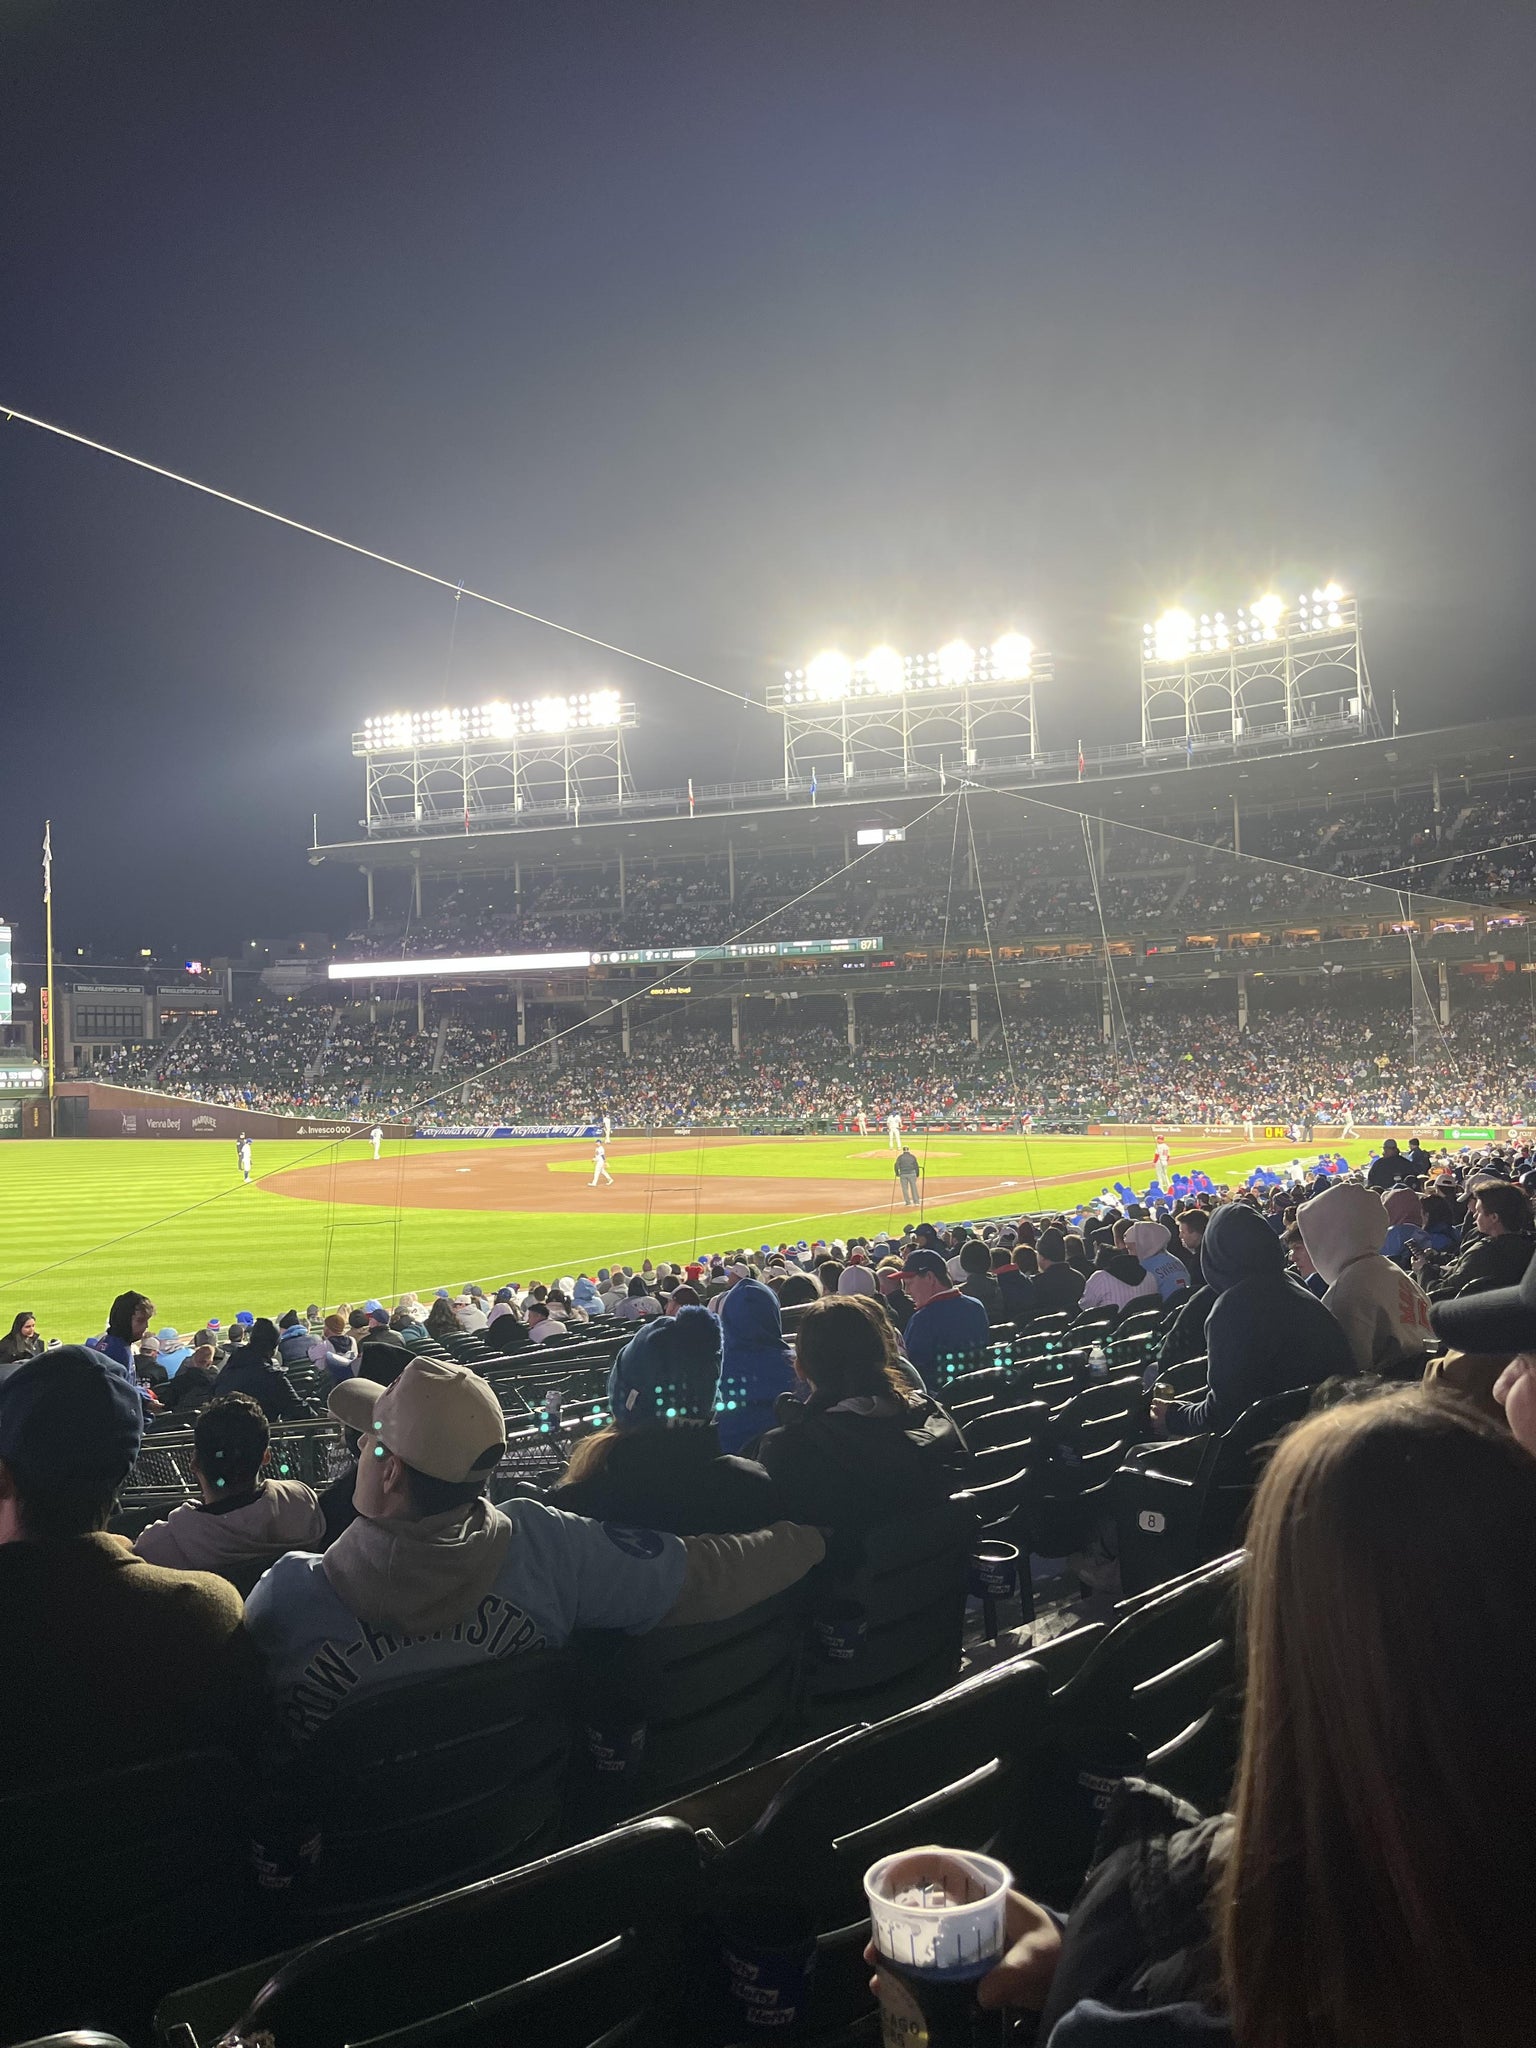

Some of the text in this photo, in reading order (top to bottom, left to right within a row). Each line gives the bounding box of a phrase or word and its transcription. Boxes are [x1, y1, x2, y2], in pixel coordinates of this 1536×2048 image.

[147, 1118, 167, 1129] Vienna
[167, 1118, 181, 1131] Beef
[308, 1126, 351, 1134] Invesco QQQ
[1147, 1514, 1156, 1528] 8
